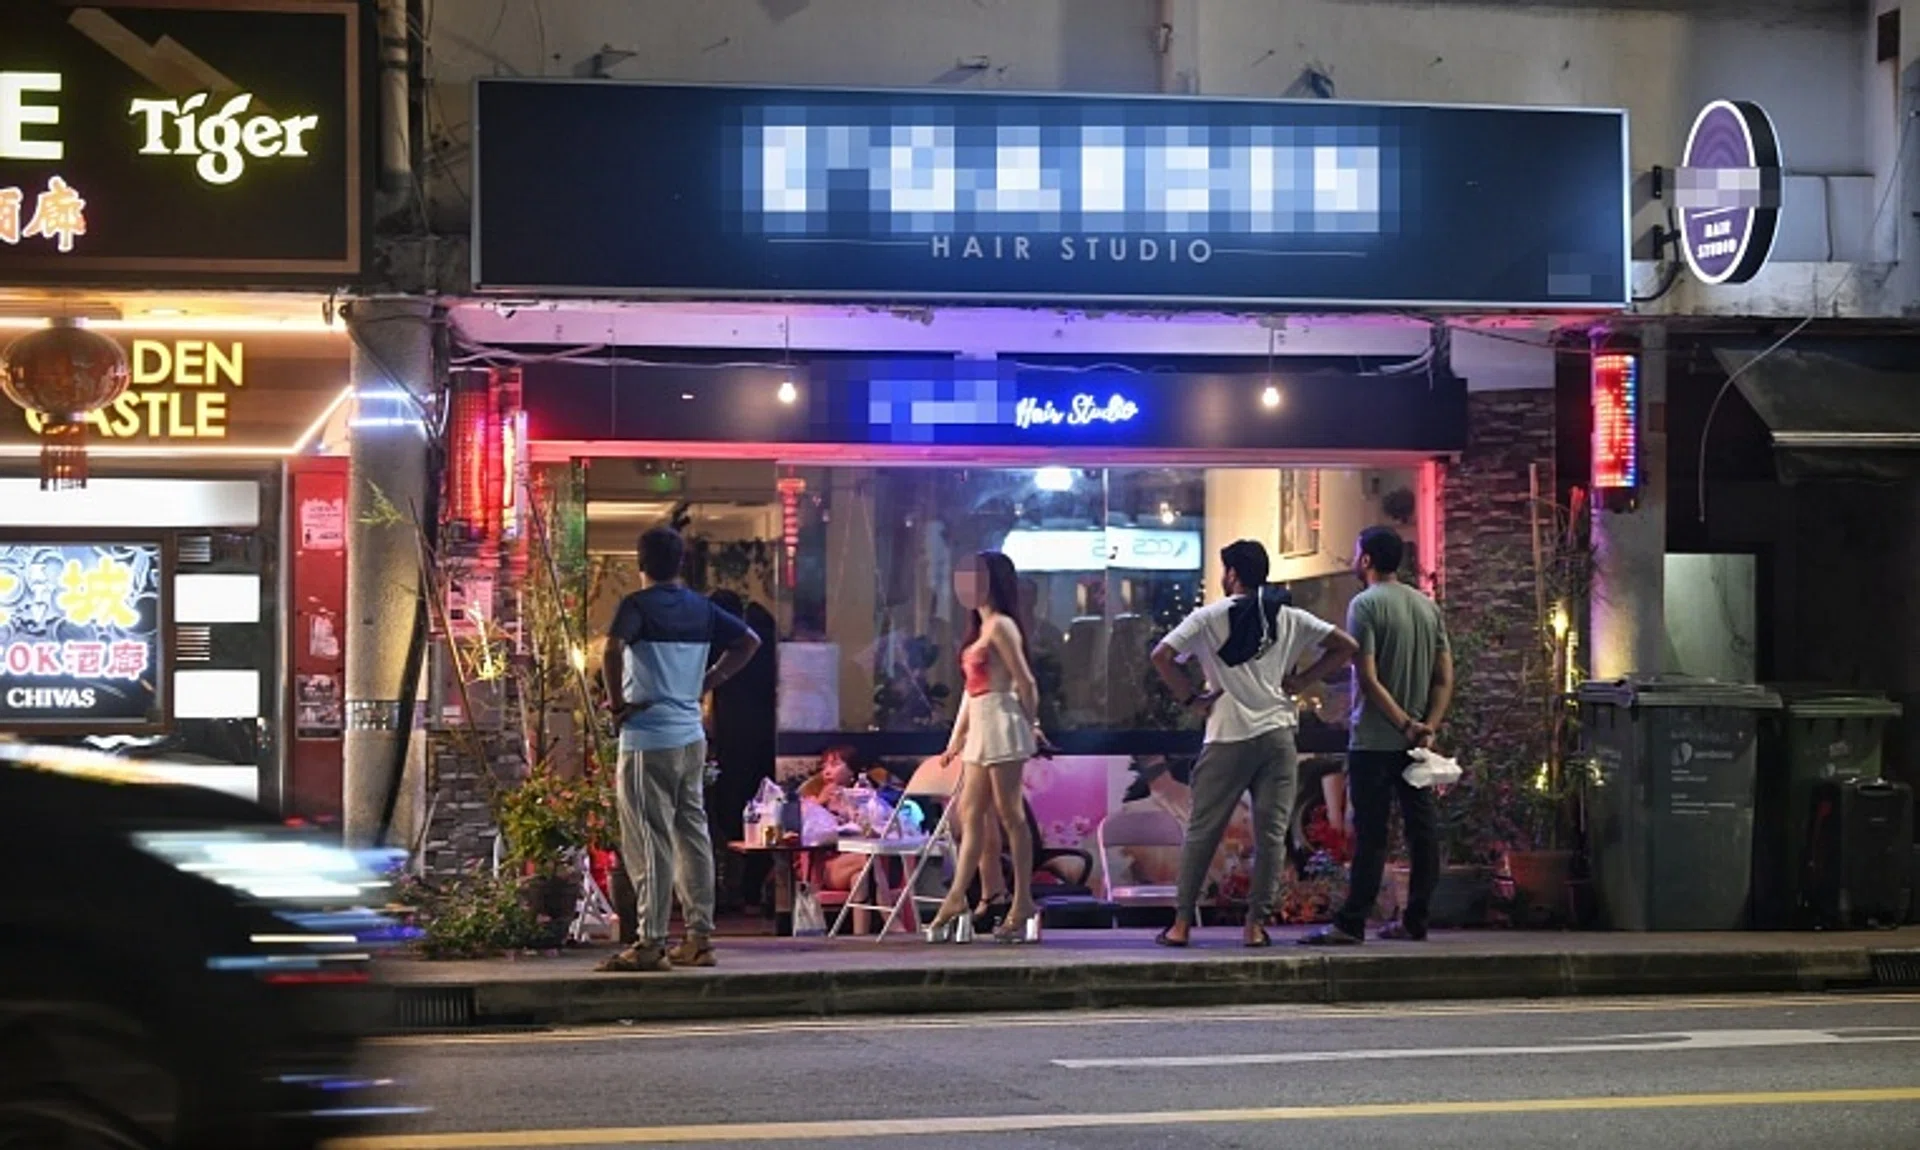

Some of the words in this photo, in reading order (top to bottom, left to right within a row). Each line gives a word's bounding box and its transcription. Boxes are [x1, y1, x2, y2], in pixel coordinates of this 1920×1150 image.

[129, 93, 318, 184] Tiger
[932, 236, 1030, 260] HAIR
[1060, 236, 1212, 263] STUDIO
[132, 339, 244, 386] DEN
[1016, 397, 1064, 429] Hair
[1067, 393, 1139, 424] Studio
[7, 687, 96, 708] CHIVAS
